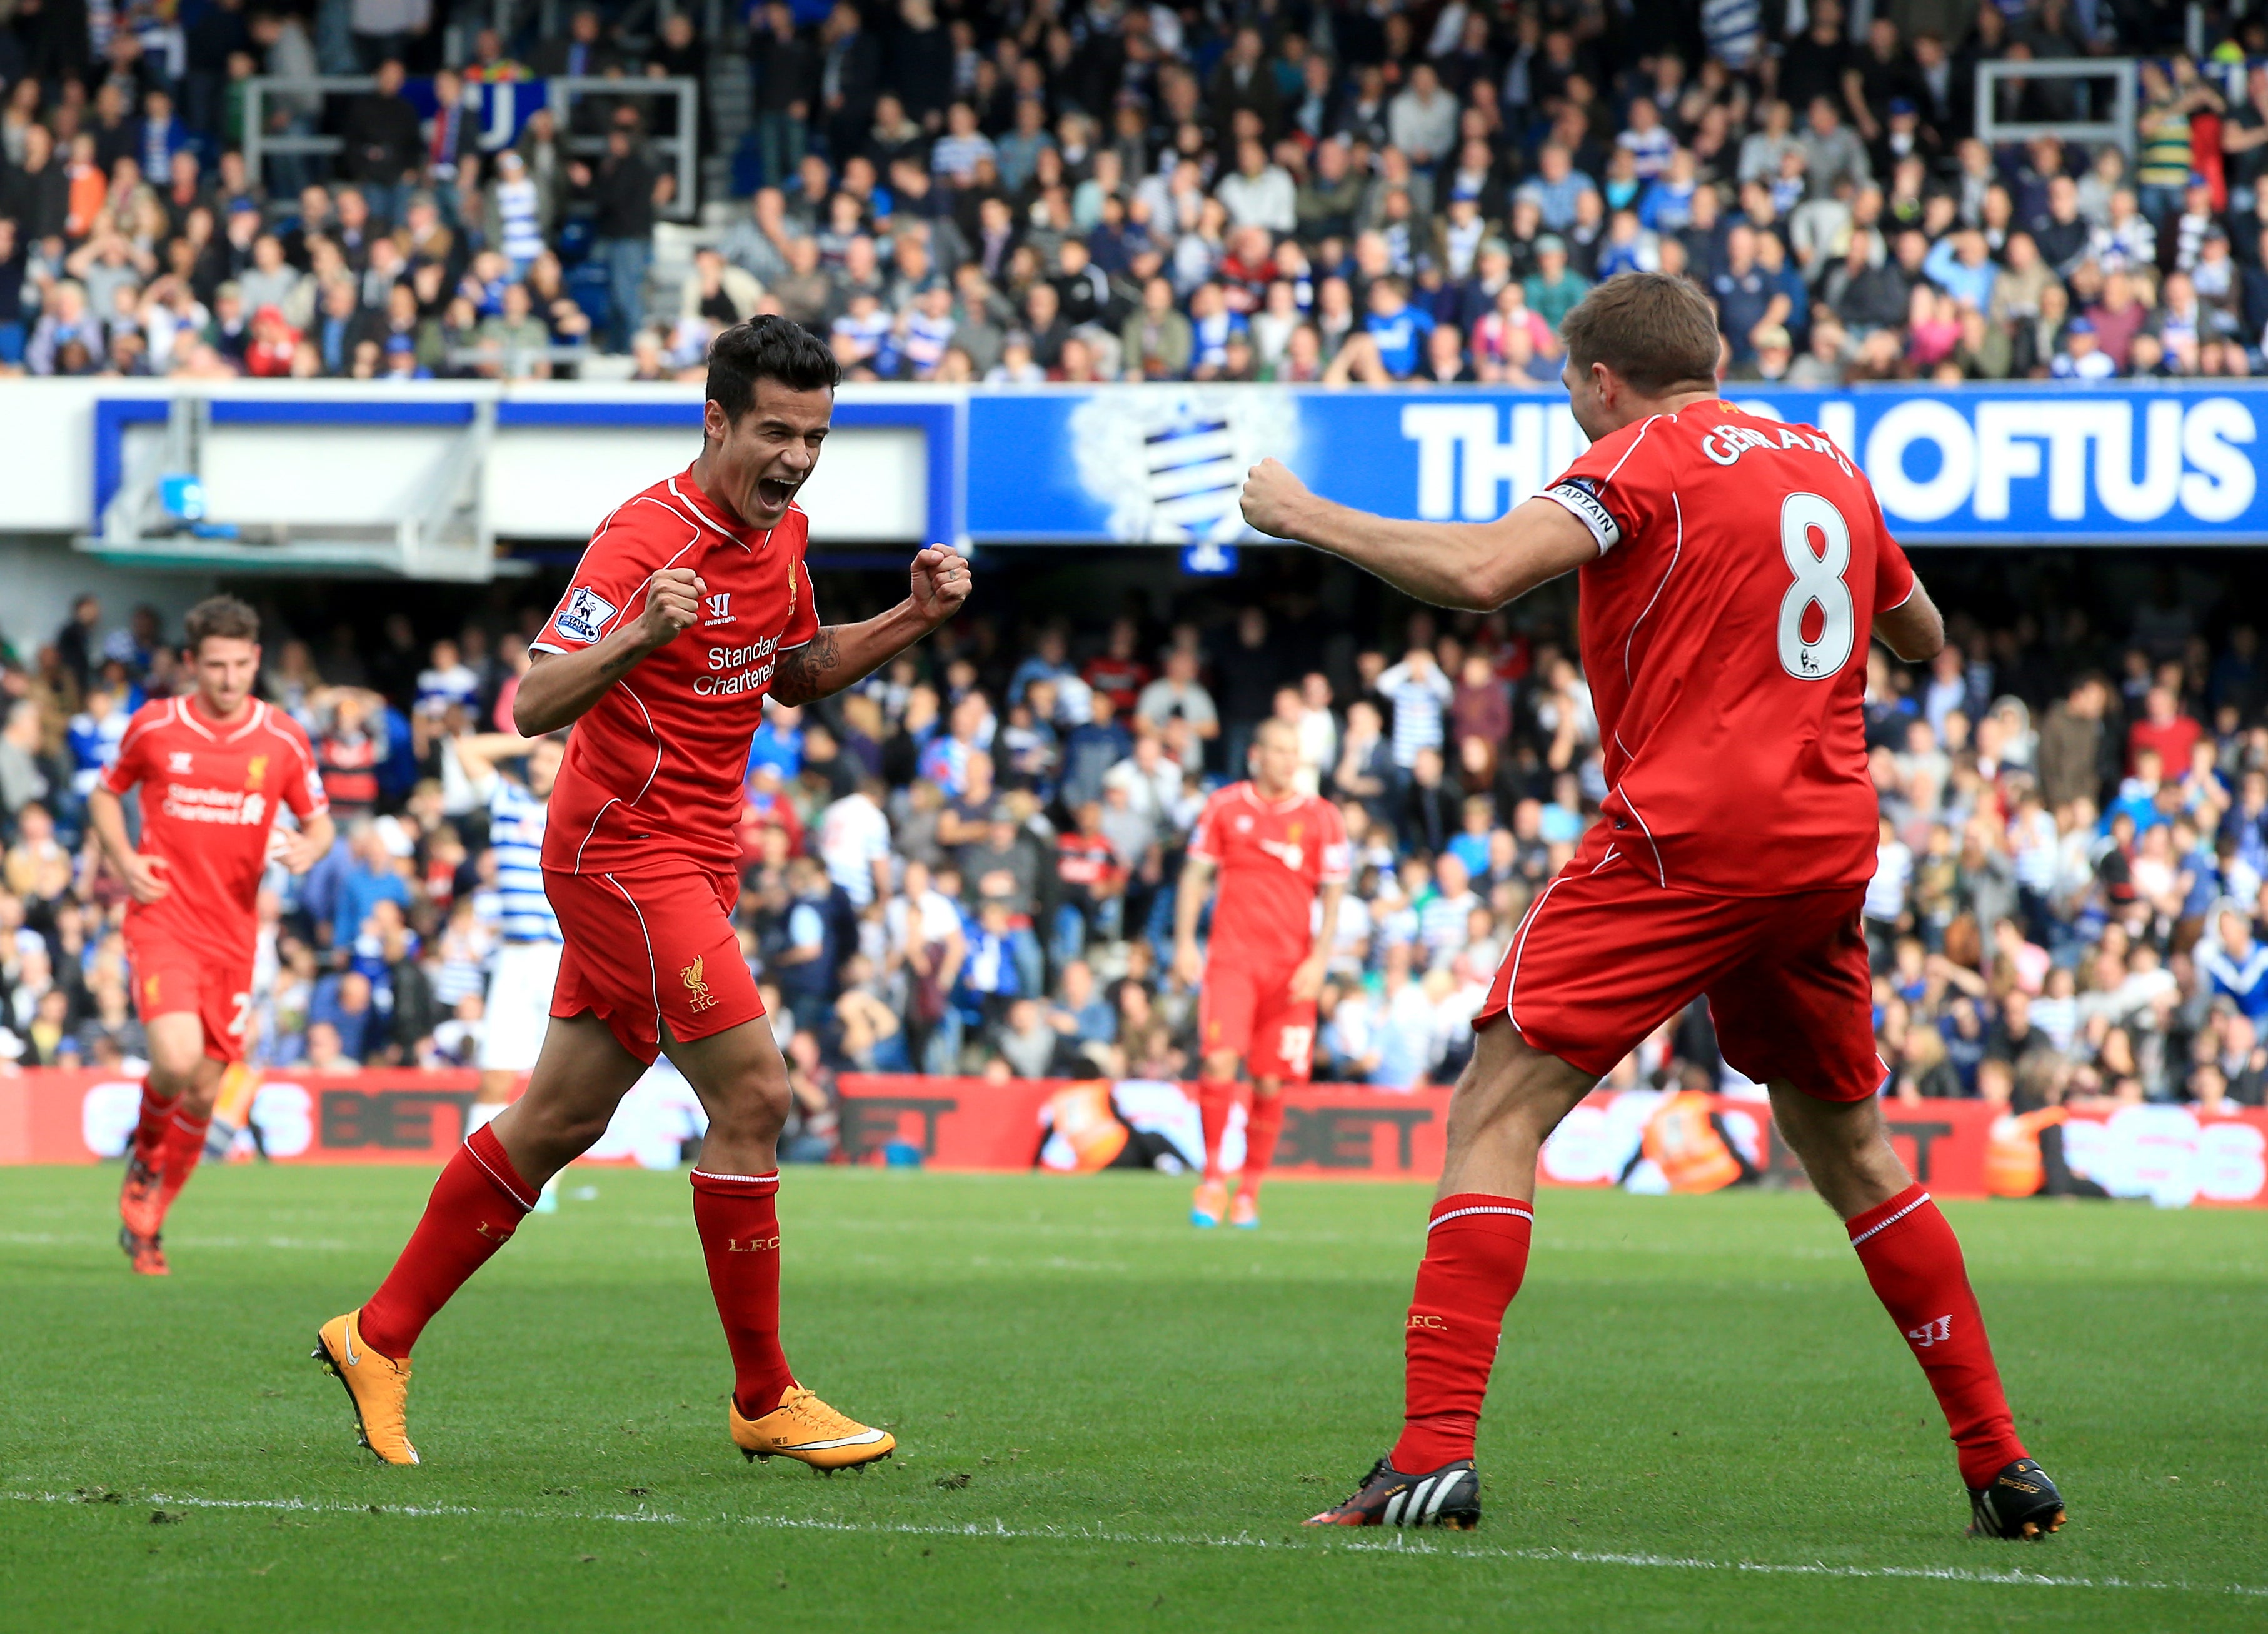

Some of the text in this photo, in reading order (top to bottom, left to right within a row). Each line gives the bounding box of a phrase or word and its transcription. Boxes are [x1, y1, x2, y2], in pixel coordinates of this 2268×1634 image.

[1401, 403, 1592, 519] THI
[1553, 486, 1613, 533] CAPTAIN
[1777, 492, 1855, 681] 8
[693, 654, 776, 696] Chartered
[162, 799, 239, 825] Chartered
[168, 783, 244, 809] Standard
[690, 996, 720, 1013] L.F.C.
[320, 1091, 476, 1149] BET
